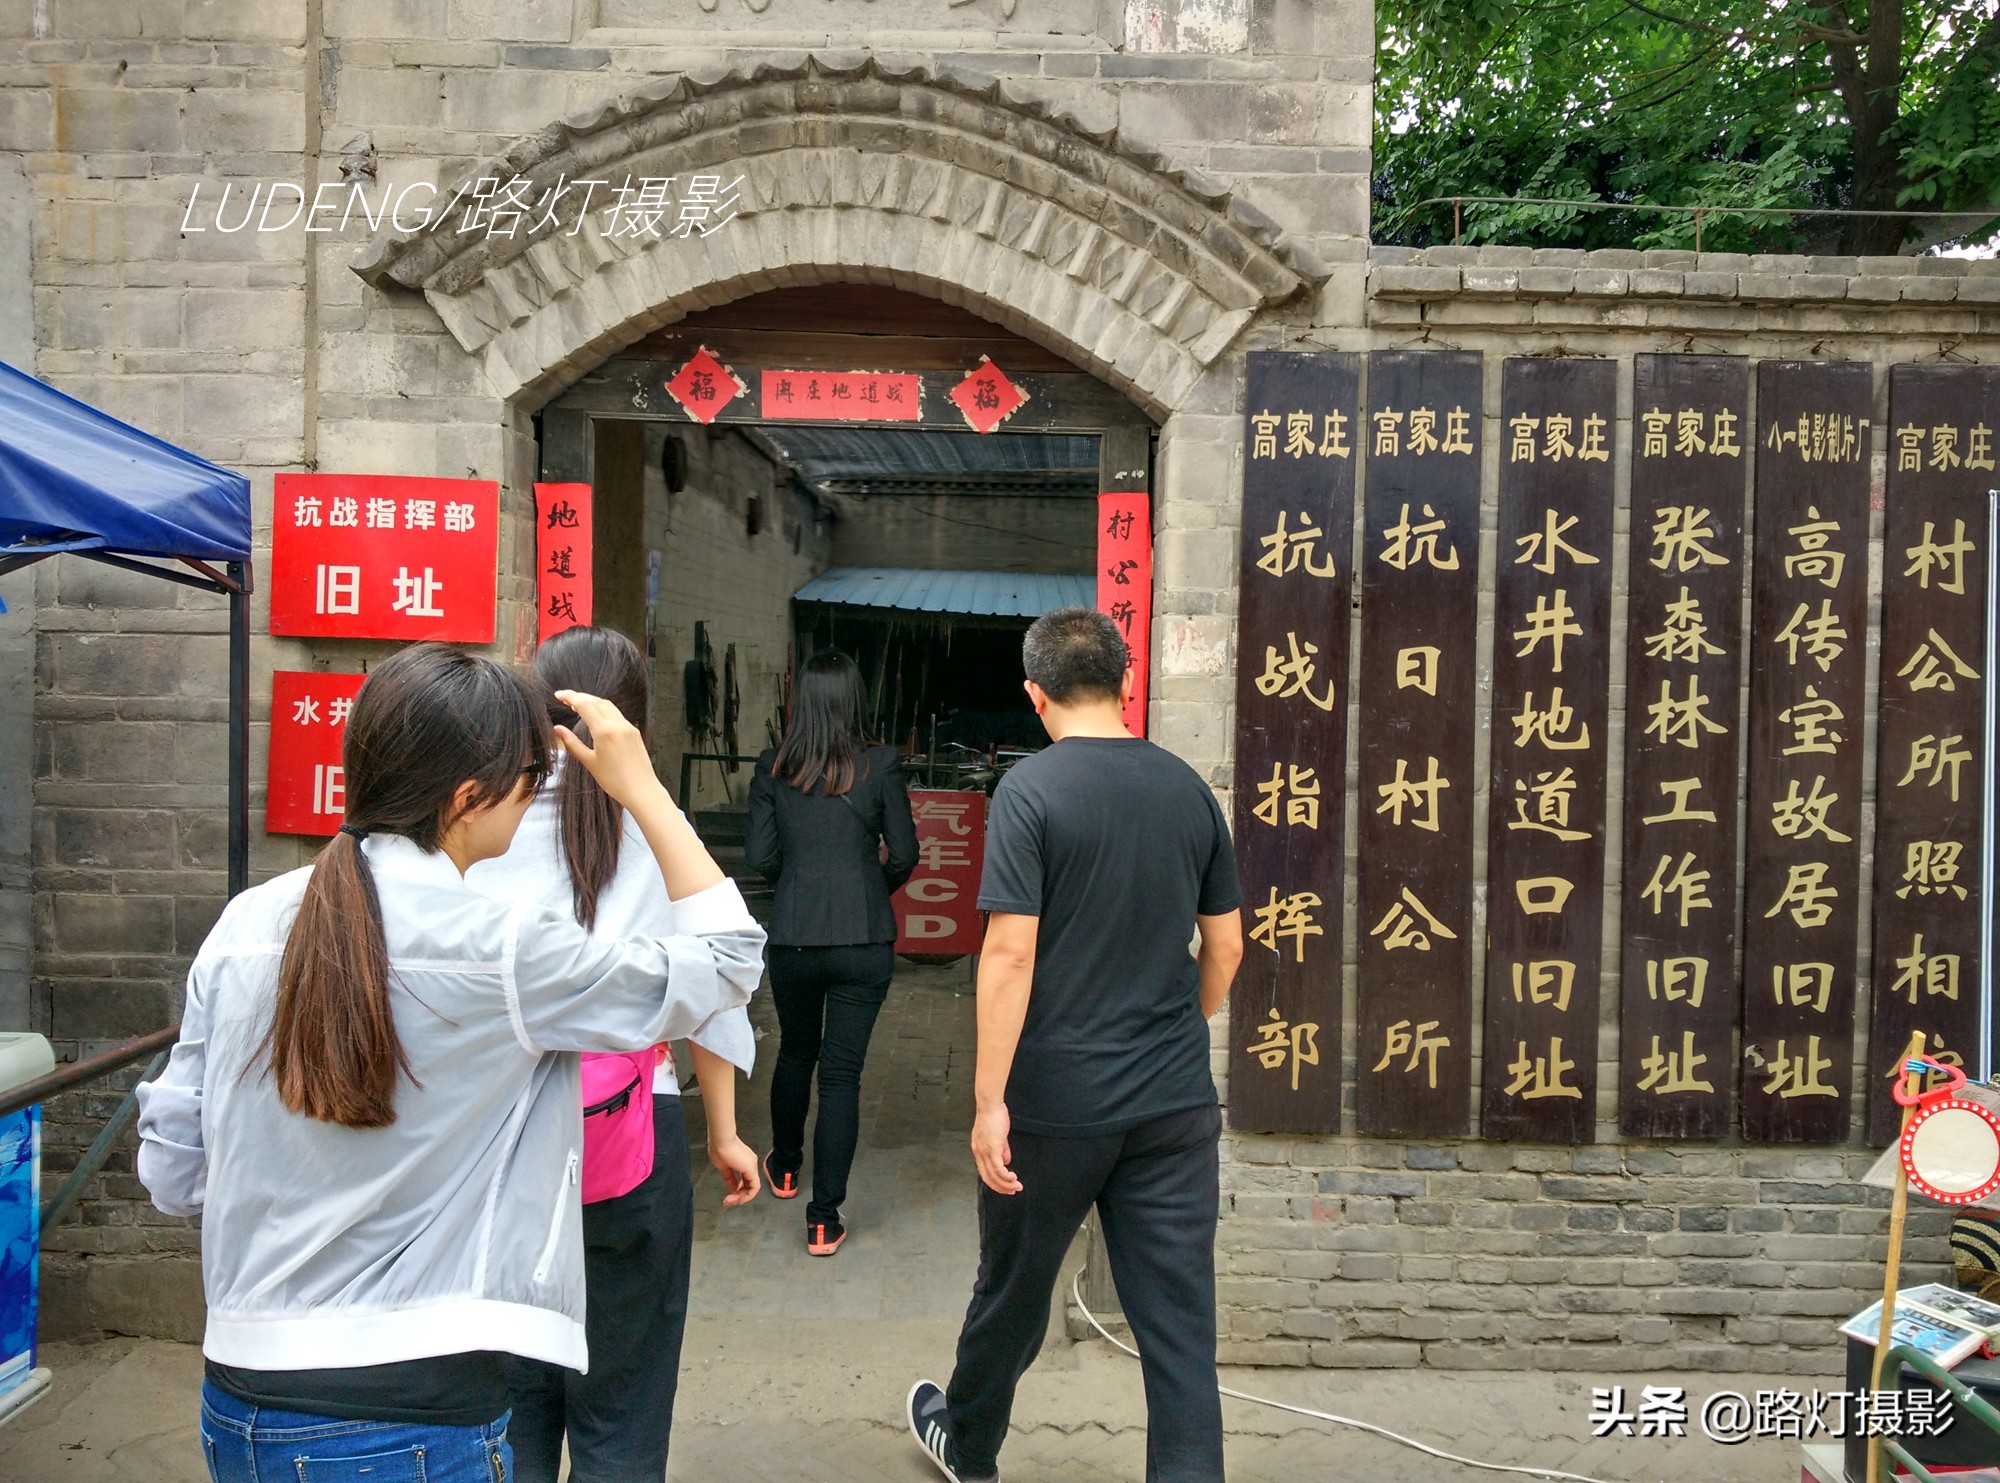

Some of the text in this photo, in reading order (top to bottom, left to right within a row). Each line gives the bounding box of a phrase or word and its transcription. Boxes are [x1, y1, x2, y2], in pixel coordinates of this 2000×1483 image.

[689, 370, 717, 401] 福
[973, 379, 1000, 411] 福
[1251, 408, 1349, 460] 高家庄
[1374, 406, 1474, 456] 高家庄
[1509, 412, 1610, 464] 高家庄
[1641, 407, 1741, 458] 高家庄
[1767, 411, 1870, 463] 八一电影制片厂
[1896, 422, 1996, 473] 高家庄
[294, 495, 477, 533] 抗战指挥部
[547, 500, 580, 622] 地道战
[315, 564, 444, 618] 旧址
[1246, 510, 1335, 1090] 抗战指挥部
[1370, 504, 1459, 1089] 抗日村公所
[1503, 508, 1600, 1101] 水井地道口旧址
[1636, 505, 1730, 1096] 张森林工作旧址
[1763, 507, 1852, 1099] 高传宝故居旧址
